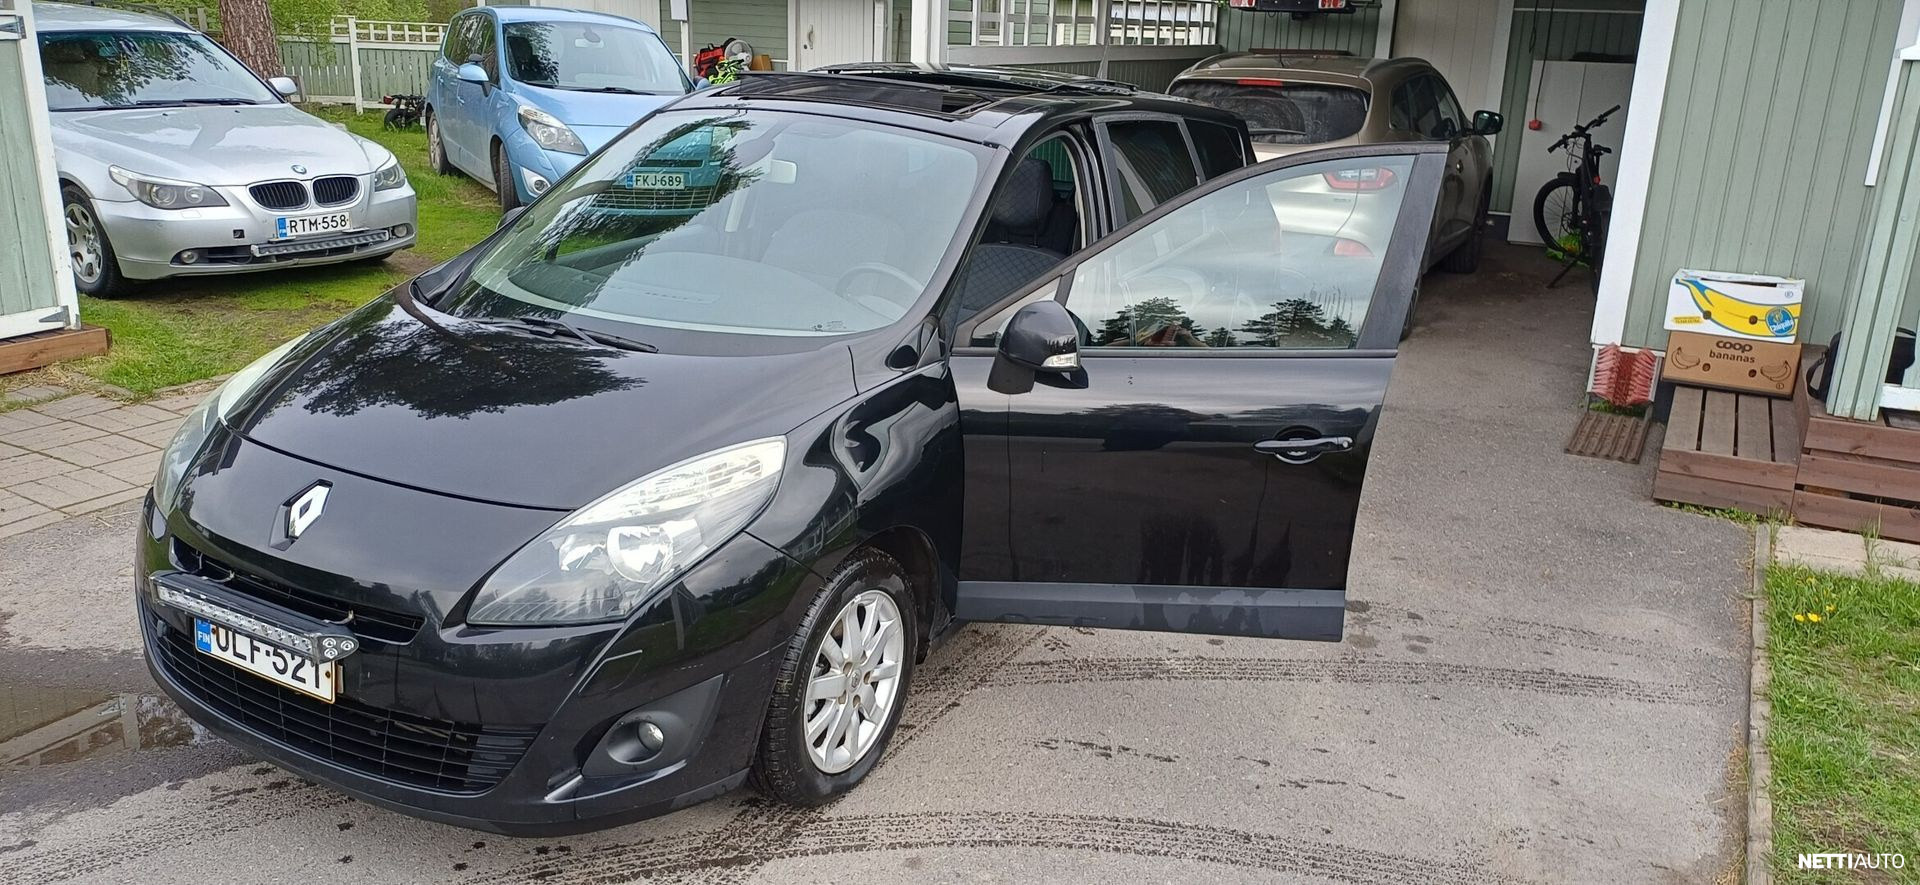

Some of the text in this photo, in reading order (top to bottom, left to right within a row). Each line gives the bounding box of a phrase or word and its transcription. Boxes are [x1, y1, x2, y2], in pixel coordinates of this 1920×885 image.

[289, 214, 347, 233] RTM-558
[1716, 340, 1753, 353] coop
[1709, 349, 1755, 363] bananas
[197, 631, 211, 644] FIN
